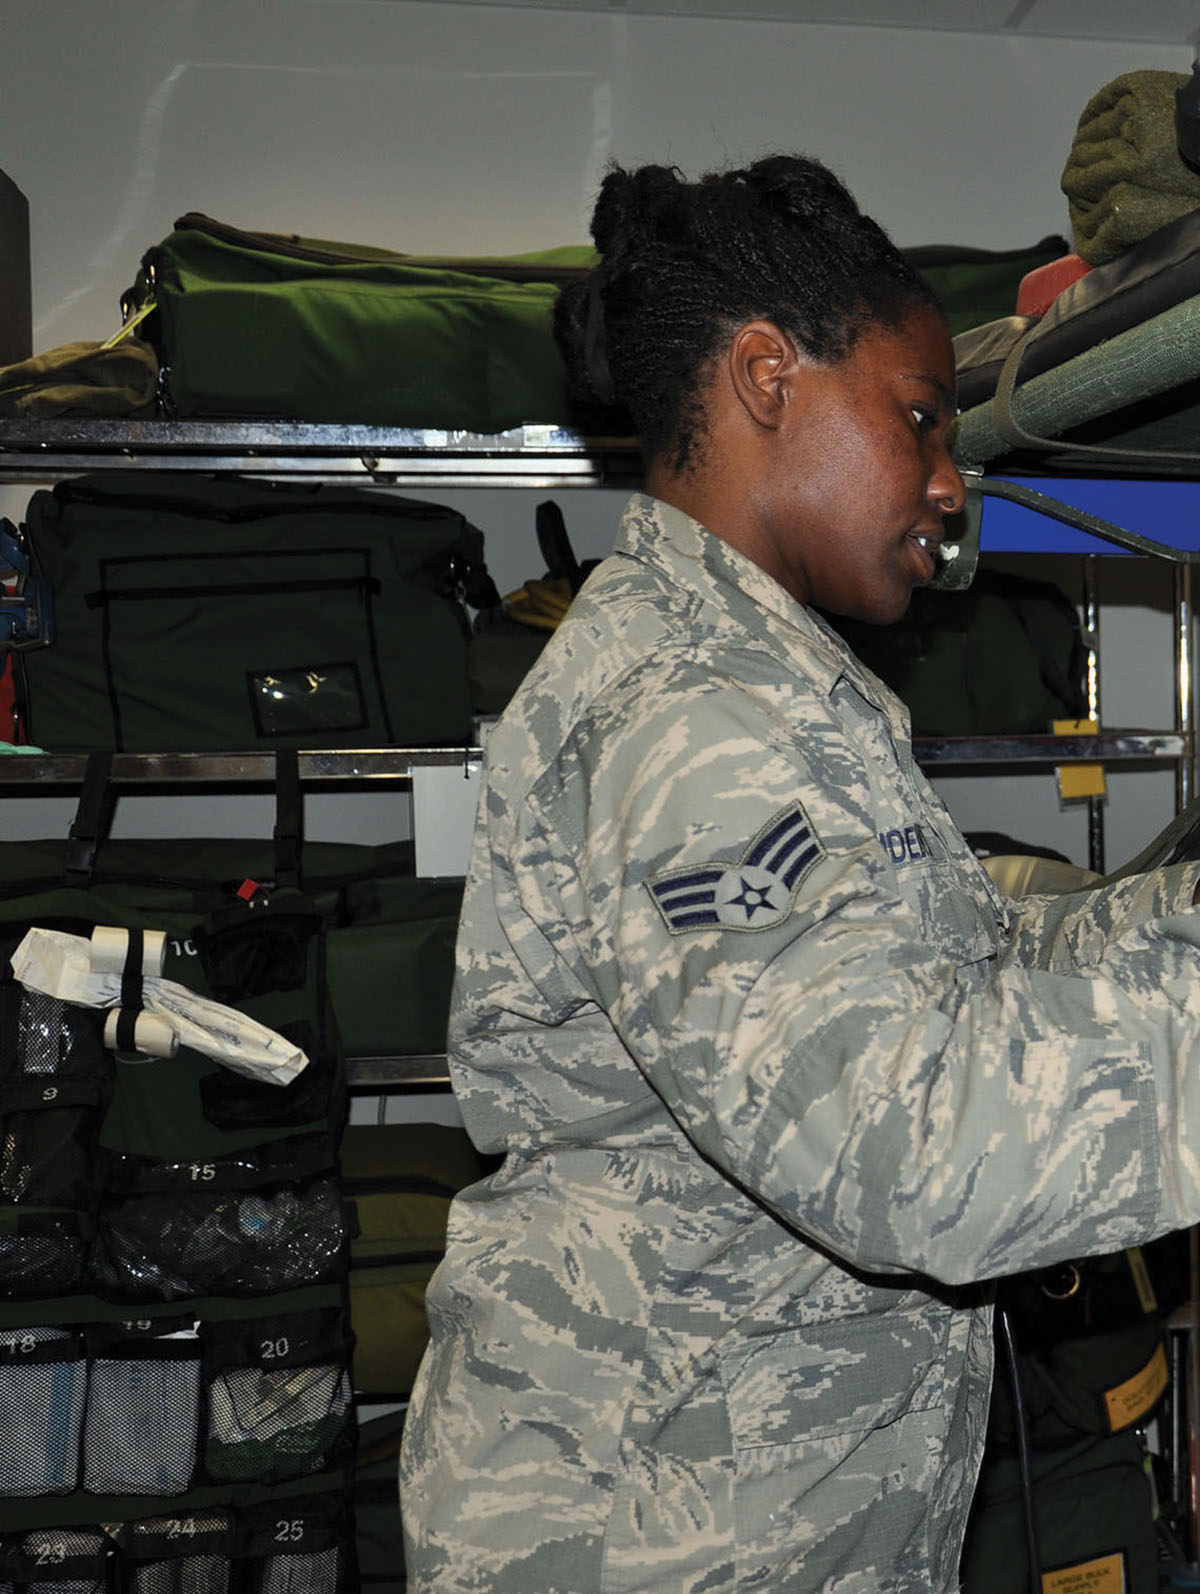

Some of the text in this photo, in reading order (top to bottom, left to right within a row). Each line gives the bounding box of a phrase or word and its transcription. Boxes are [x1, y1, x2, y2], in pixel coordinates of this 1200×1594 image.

[42, 1086, 58, 1101] 9
[188, 1163, 217, 1182] 15
[6, 1335, 37, 1354] 18
[260, 1336, 290, 1359] 20
[274, 1519, 305, 1542] 25
